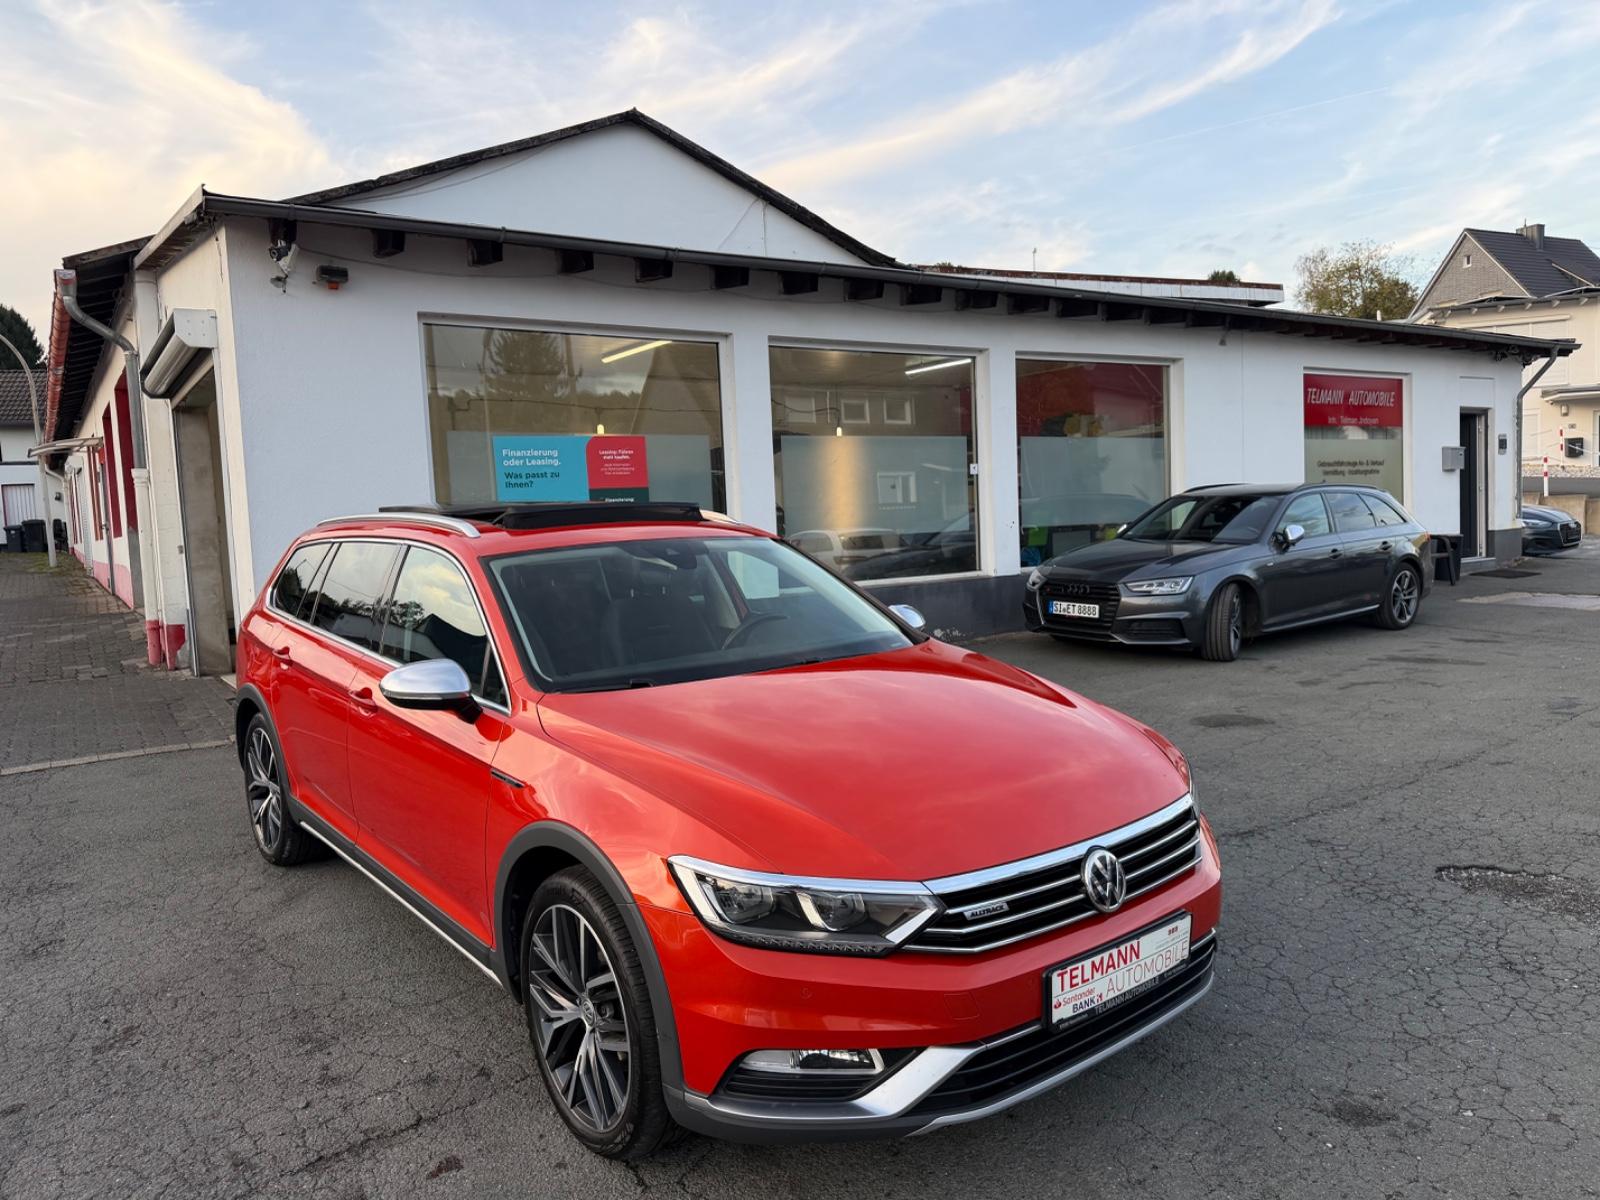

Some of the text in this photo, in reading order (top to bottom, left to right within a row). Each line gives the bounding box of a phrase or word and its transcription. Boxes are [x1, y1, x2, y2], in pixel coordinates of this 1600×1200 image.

[1307, 388, 1395, 406] TELMANN AUTOMOBILE
[502, 448, 558, 457] Finanzierung
[503, 457, 562, 467] oder Leasing.
[504, 471, 560, 480] Was passt zu
[505, 480, 534, 489] Ihnen?
[1053, 603, 1097, 616] SI ET 8888
[969, 904, 1006, 918] ALLTRACK
[1057, 940, 1141, 993] TELMANN
[1105, 939, 1189, 998] AUTOMOBILE
[1062, 986, 1096, 1007] Santander
[1094, 993, 1126, 1016] TELMANN
[1124, 975, 1160, 1001] AUTOMOBILE
[1072, 995, 1096, 1014] BANK
